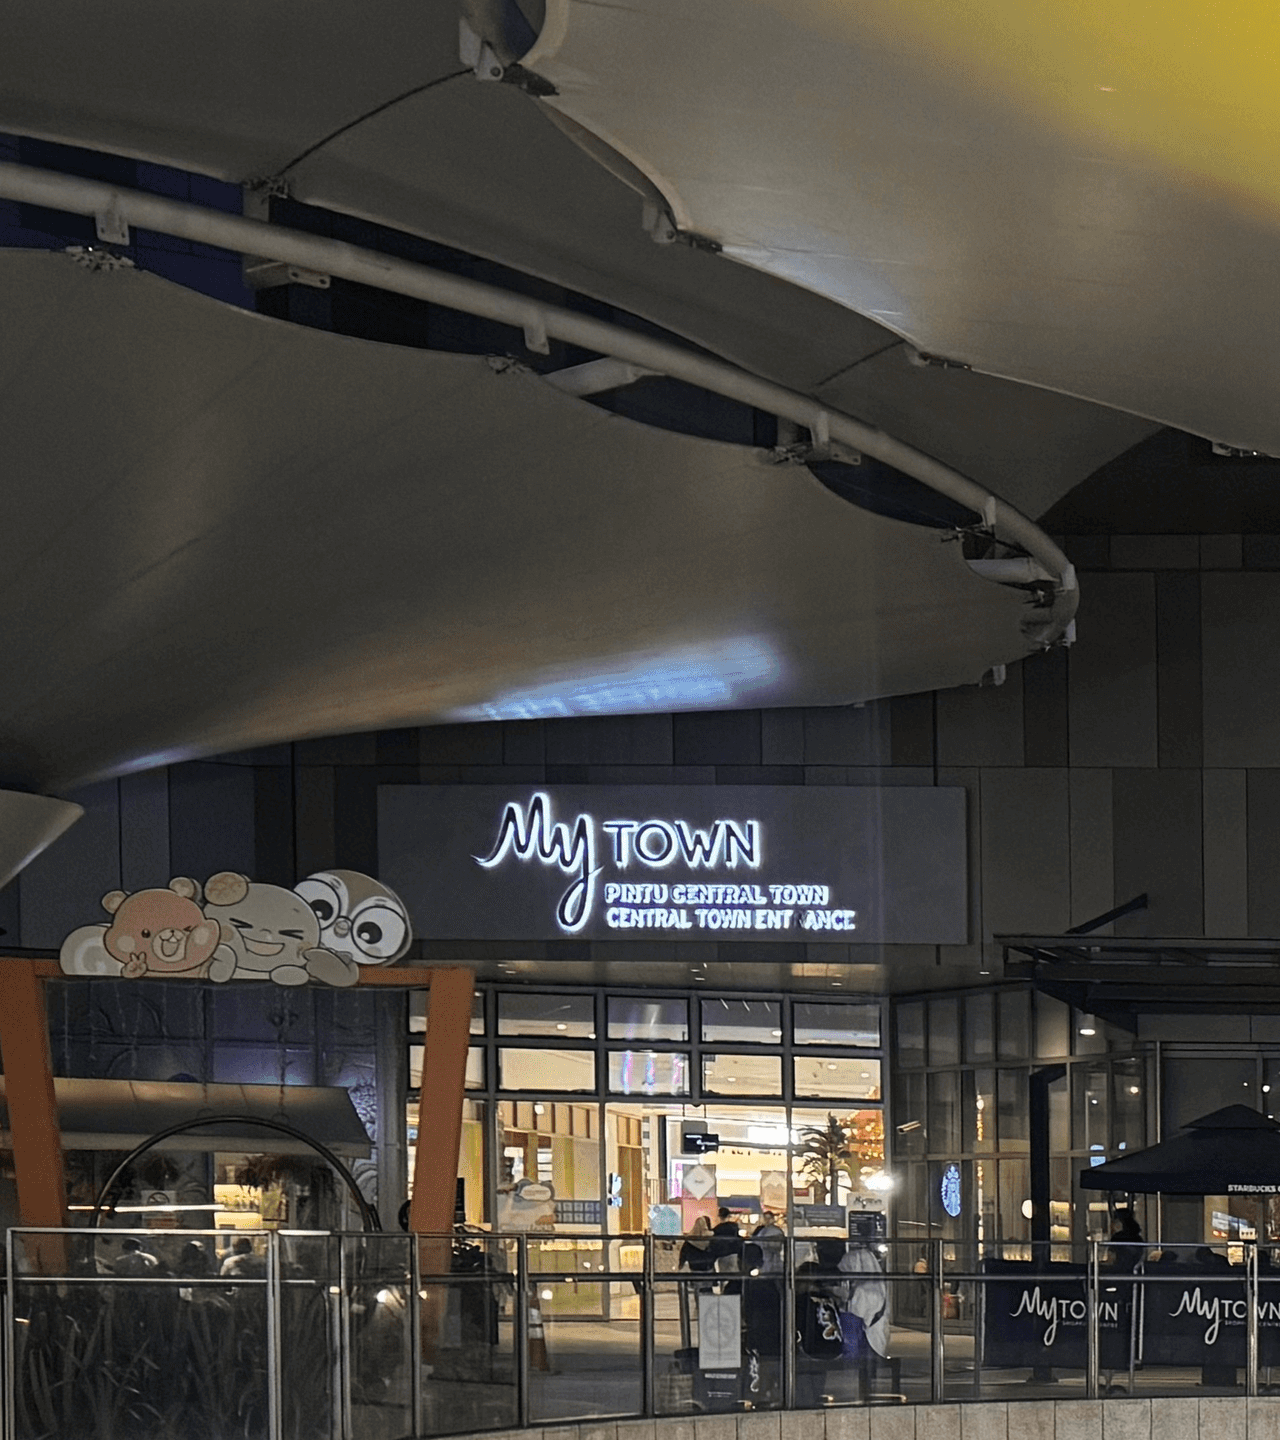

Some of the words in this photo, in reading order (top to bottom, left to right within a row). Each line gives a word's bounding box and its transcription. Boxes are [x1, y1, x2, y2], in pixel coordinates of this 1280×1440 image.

[605, 883, 669, 904] PINTU
[671, 884, 768, 905] CENTRAL
[769, 885, 829, 905] TOWN
[606, 907, 693, 929] CENTRAL
[694, 908, 753, 929] TOWN
[754, 909, 856, 930] ENTANCE
